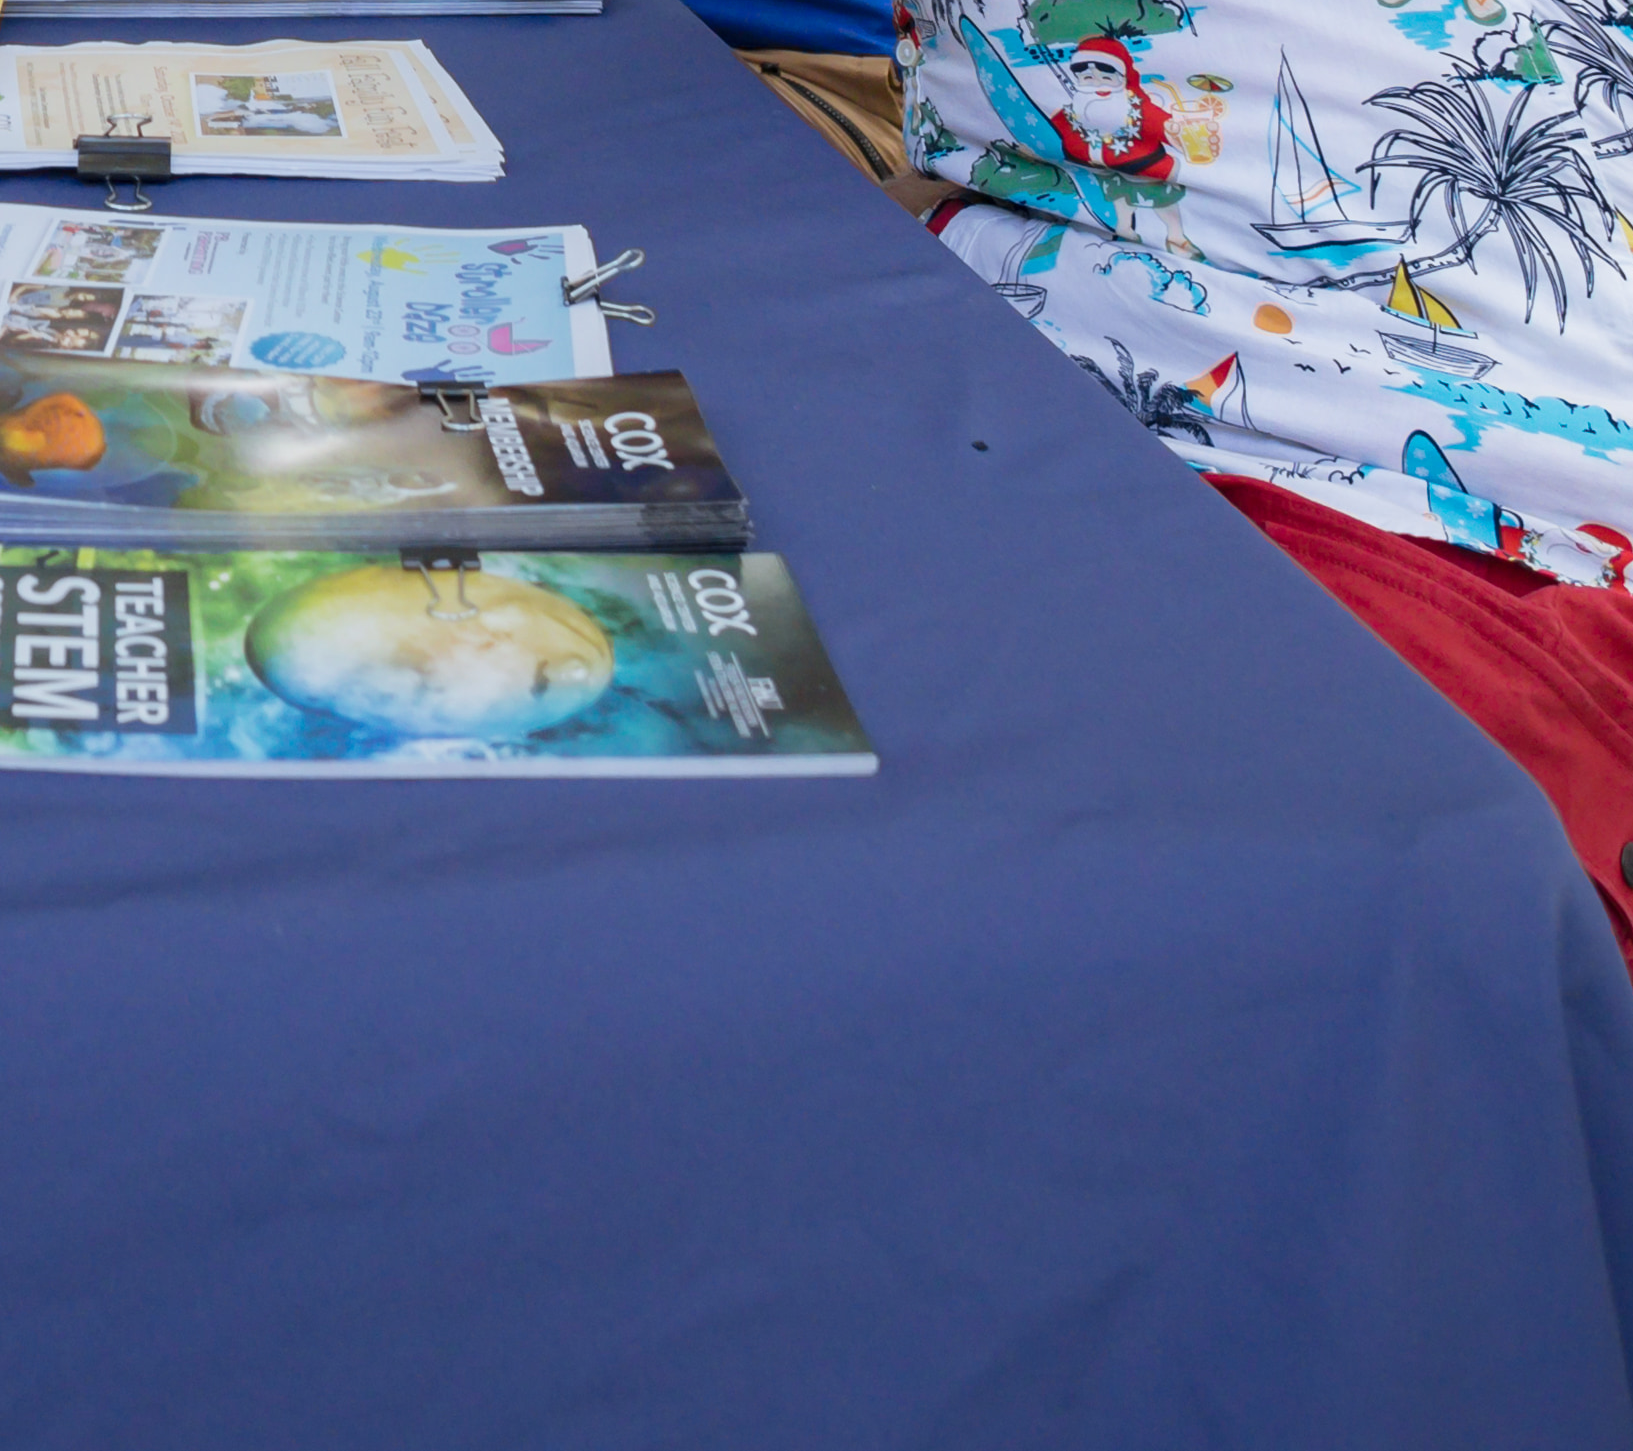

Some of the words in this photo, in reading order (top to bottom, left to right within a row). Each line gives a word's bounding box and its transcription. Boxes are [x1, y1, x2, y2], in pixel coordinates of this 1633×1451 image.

[455, 262, 513, 326] Stroller
[476, 397, 545, 497] MEMBERSHIP
[603, 410, 676, 472] COX
[687, 569, 759, 638] COX
[11, 573, 101, 721] STEM
[115, 576, 168, 725] TEACHER
